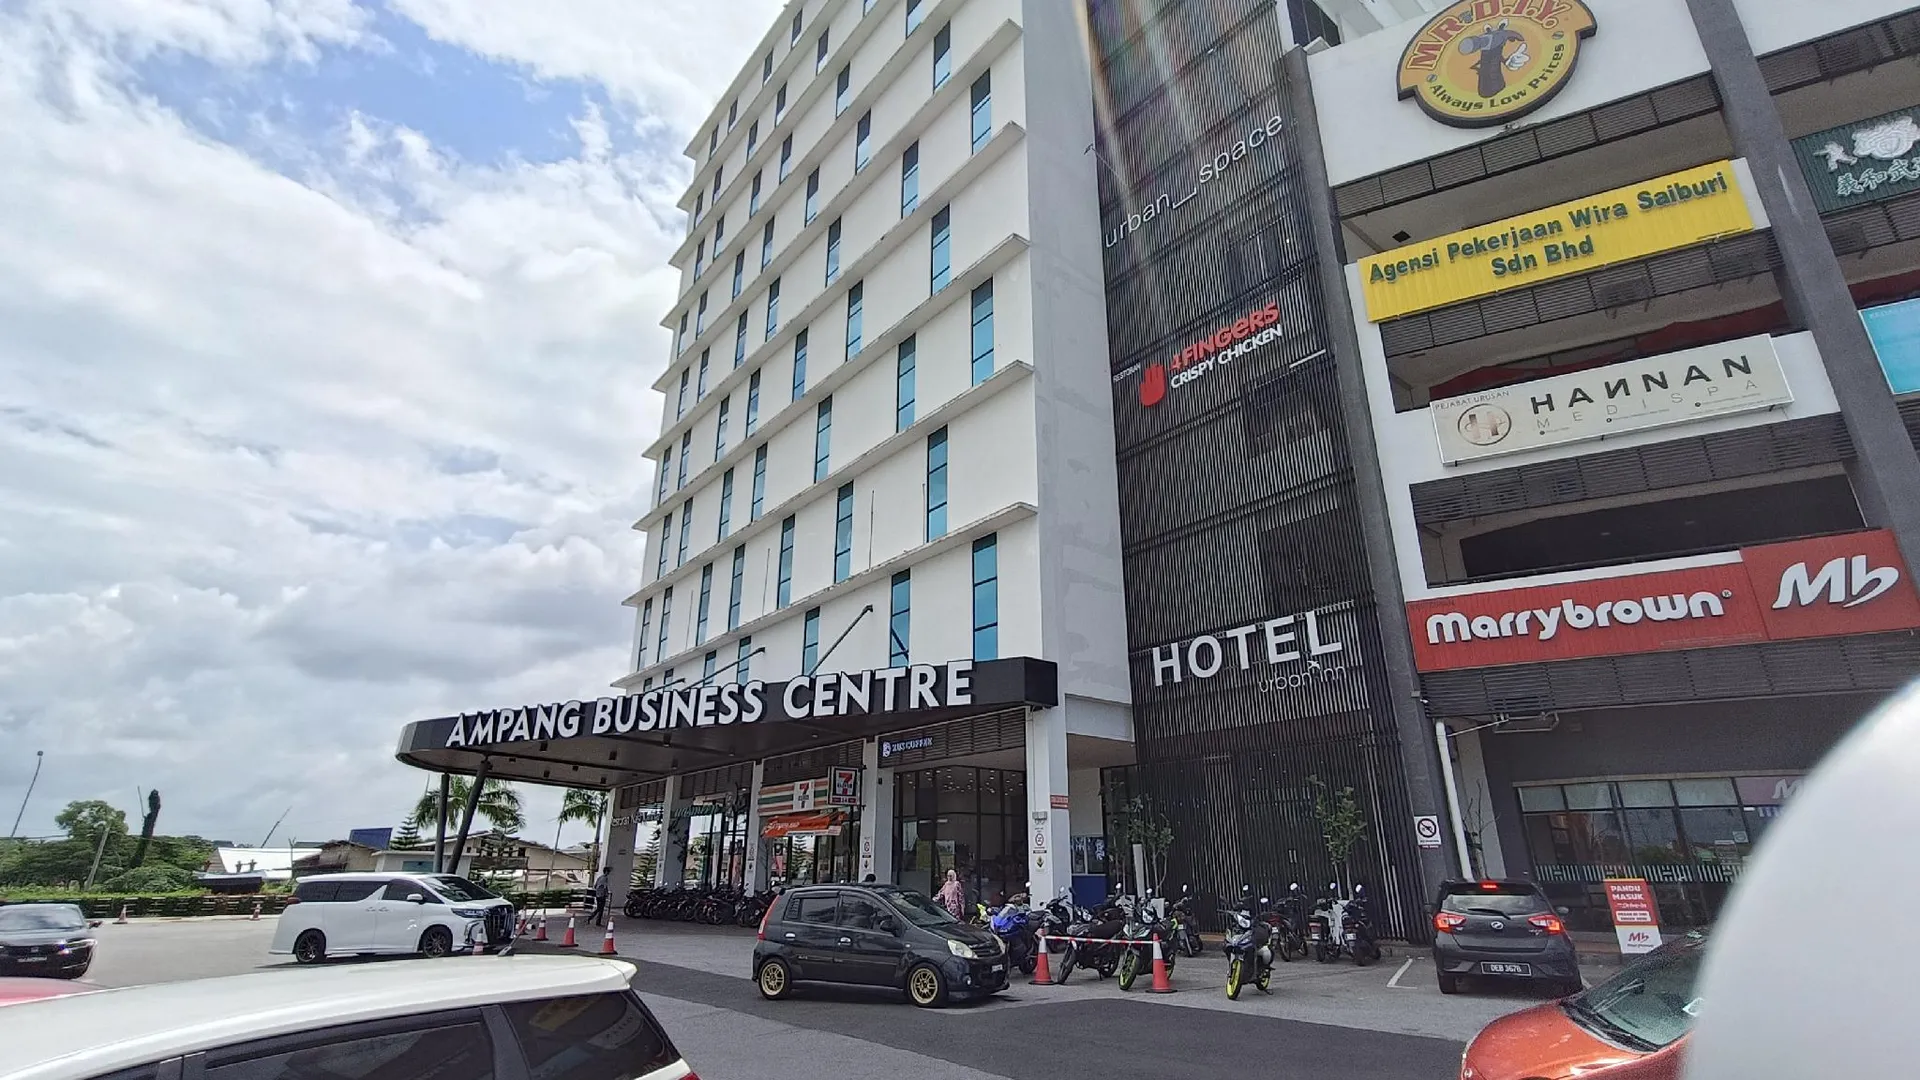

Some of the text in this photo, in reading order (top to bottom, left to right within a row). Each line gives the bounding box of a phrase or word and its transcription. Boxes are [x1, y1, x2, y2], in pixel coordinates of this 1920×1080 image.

[1430, 43, 1565, 111] Always Low Prices
[1369, 171, 1728, 284] Agensi Pekerjaan Wira Saiburi
[1491, 234, 1595, 278] Sdn Bhd
[1170, 324, 1283, 389] CRISPY CHICKEN
[1434, 390, 1510, 411] PEJABAT URUSAN
[1771, 553, 1900, 610] Mb
[1152, 610, 1343, 687] HOTEL
[444, 660, 974, 749] AMPANG BUSINESS CENTRE
[1258, 671, 1312, 693] urban
